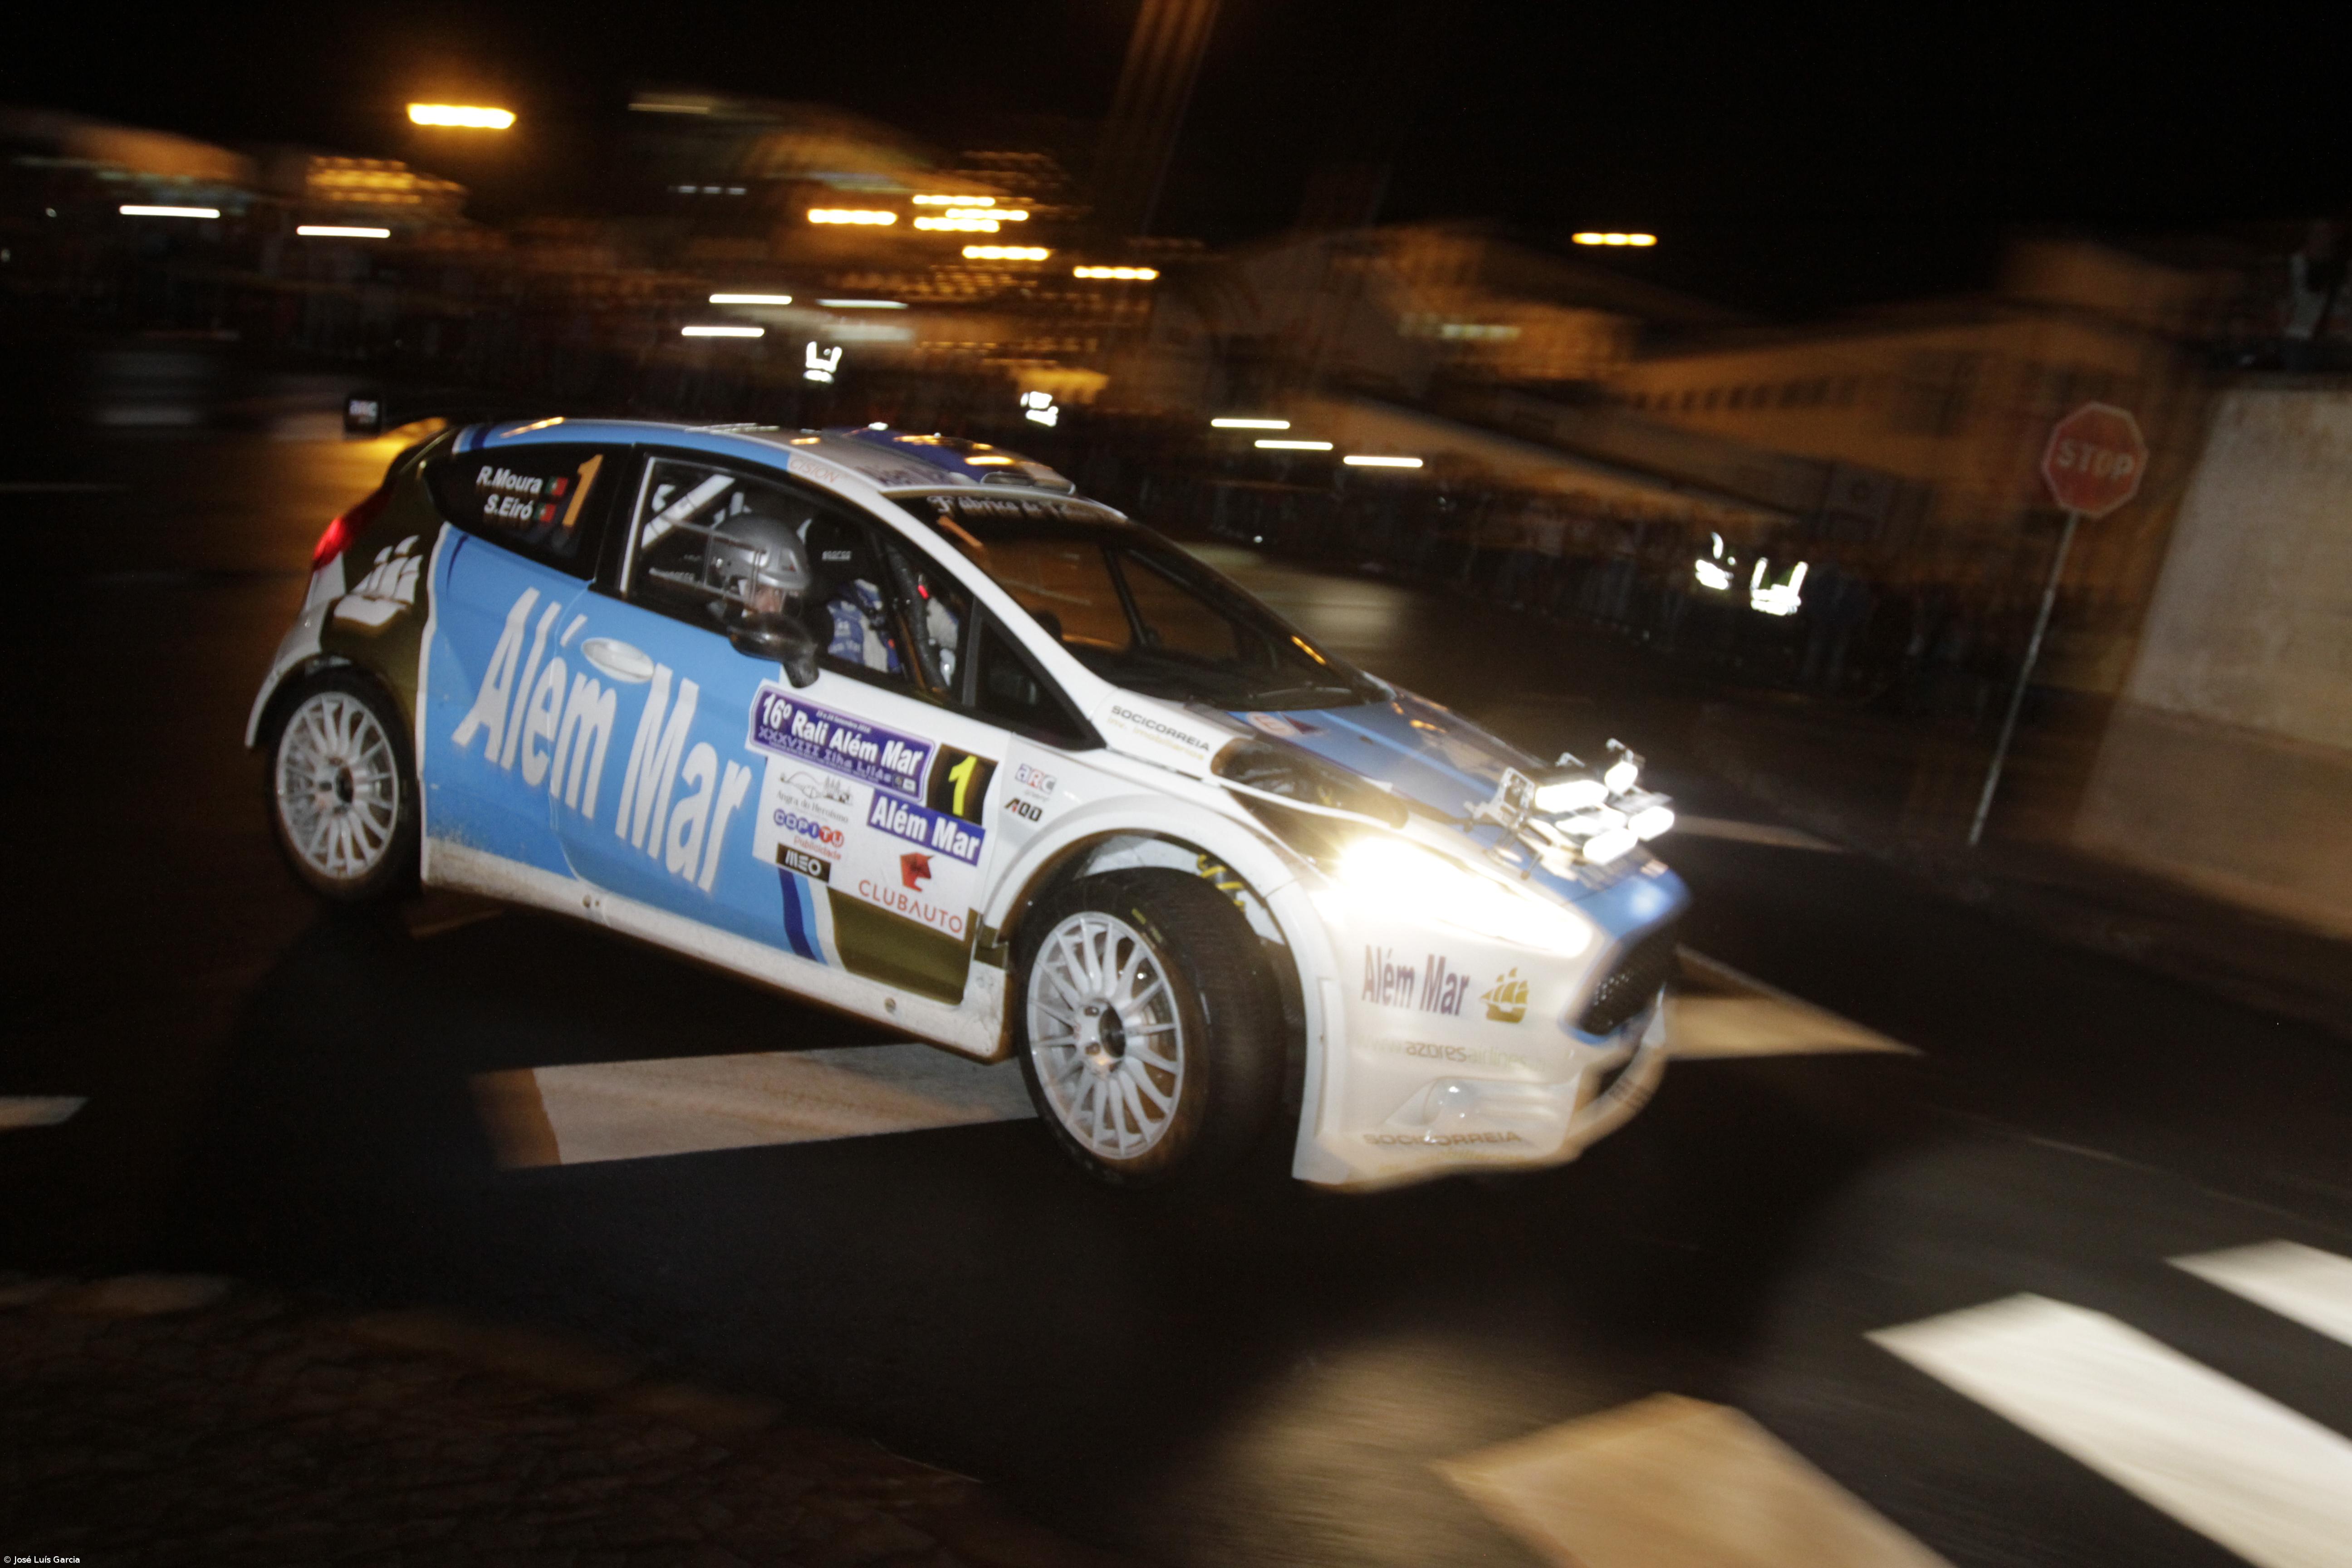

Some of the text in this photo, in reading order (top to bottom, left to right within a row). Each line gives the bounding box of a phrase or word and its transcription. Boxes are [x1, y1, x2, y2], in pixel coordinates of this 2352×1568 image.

[475, 465, 544, 494] R.Moura
[2057, 438, 2135, 483] STOP
[483, 494, 535, 520] S.Eiró
[562, 454, 603, 527] 1
[451, 586, 752, 893] Além Mar
[758, 725, 820, 756] XXXVIII
[791, 710, 829, 745] Rali
[829, 728, 879, 763] Além
[881, 740, 924, 776] Mar
[1111, 705, 1210, 751] SOCICORREIA
[948, 755, 977, 816] 1
[870, 793, 982, 861] Além Mar
[785, 849, 822, 876] MEO
[858, 879, 963, 933] CLUBAUTO
[1362, 944, 1470, 1016] Além Mar
